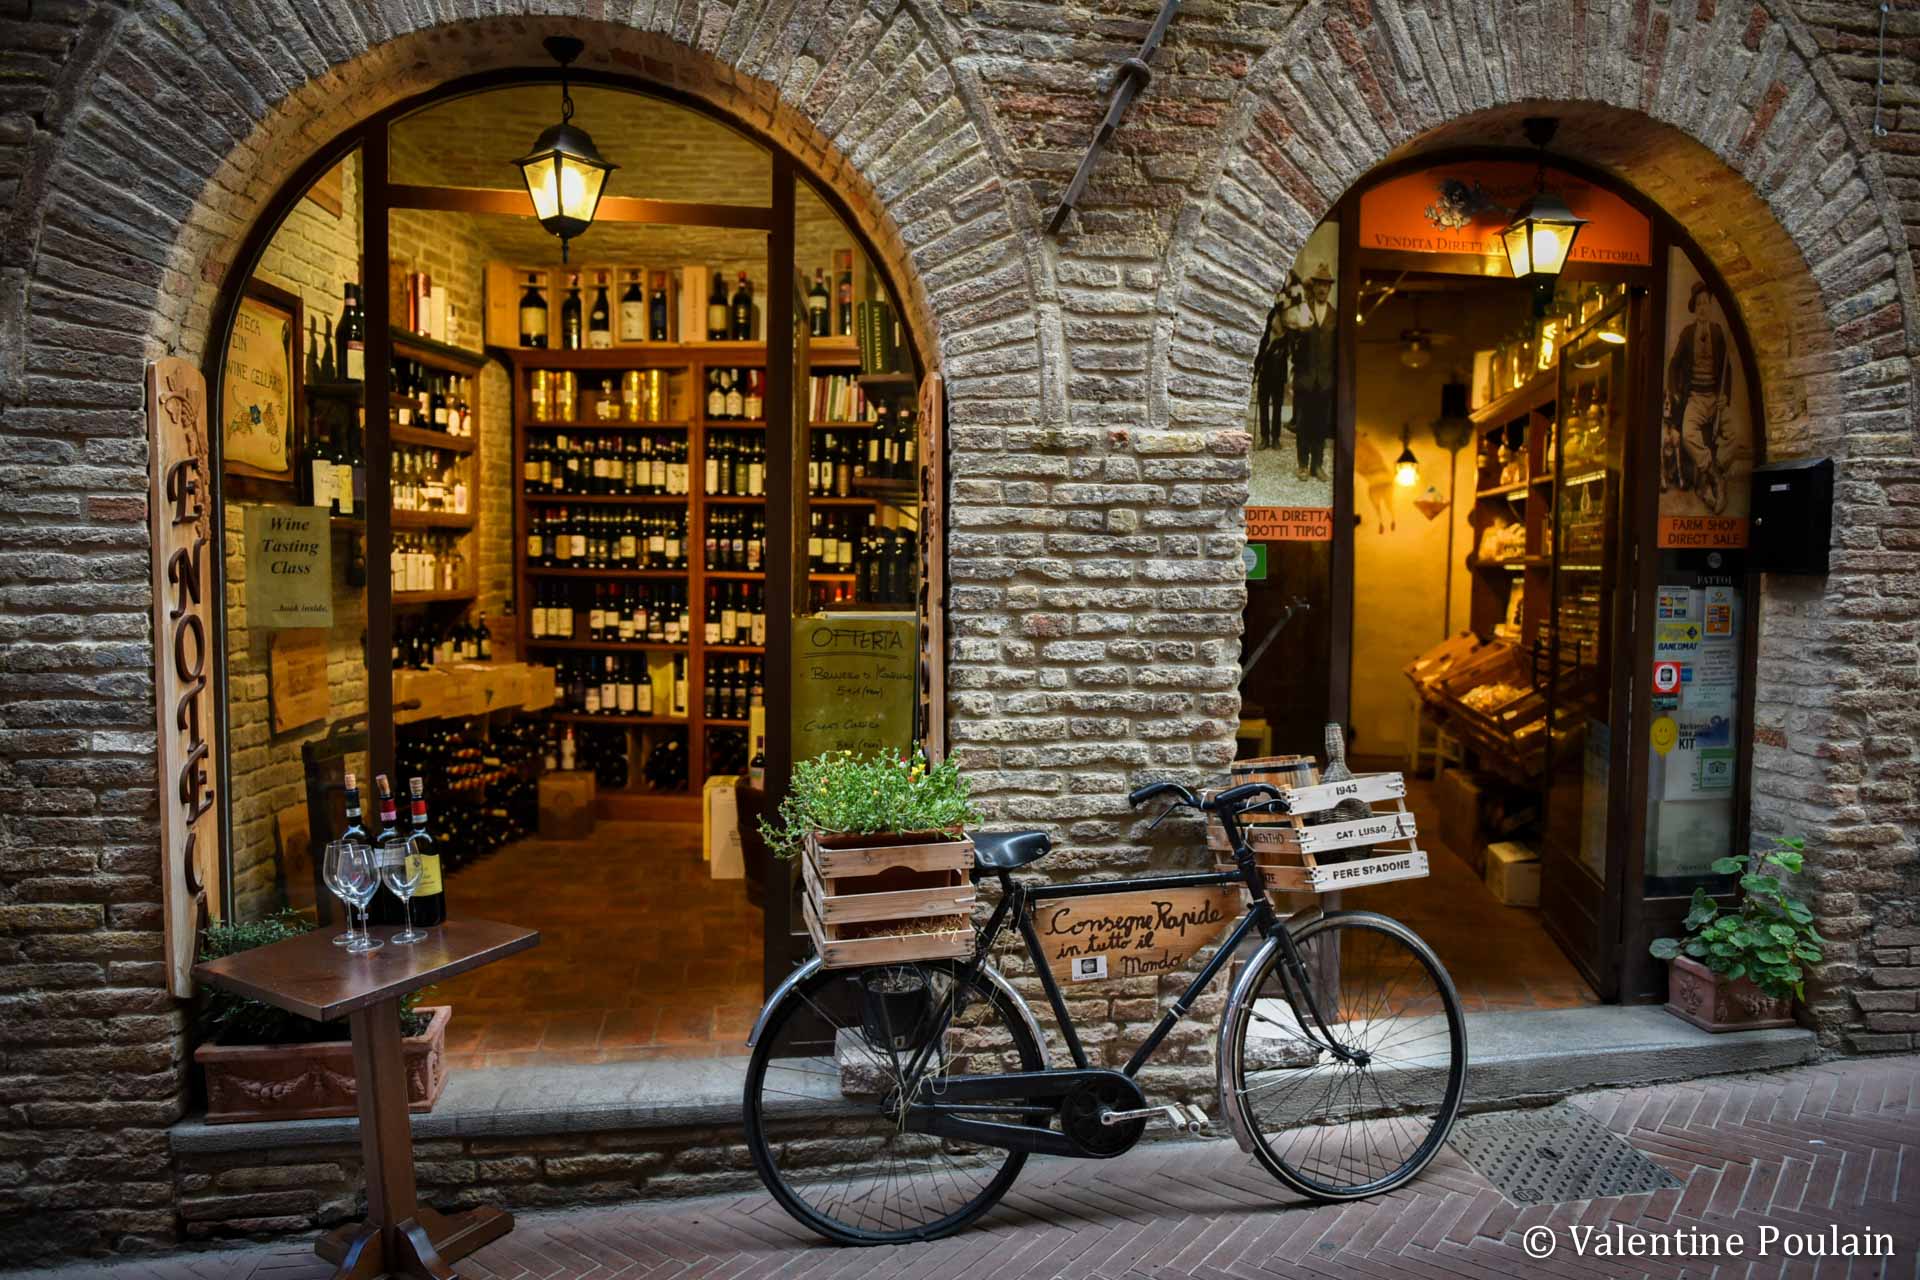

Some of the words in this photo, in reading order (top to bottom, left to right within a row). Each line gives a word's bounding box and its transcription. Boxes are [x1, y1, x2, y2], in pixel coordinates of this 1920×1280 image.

[1375, 234, 1433, 249] VENDITA
[1580, 246, 1641, 262] FATTORIA
[1282, 510, 1333, 522] DIRETTA
[271, 517, 310, 531] Wine
[1294, 525, 1328, 536] TIPICI
[1672, 519, 1703, 530] FARM
[1708, 519, 1737, 530] SHOP
[1668, 534, 1707, 545] DIRECT
[1712, 534, 1740, 545] SALE
[262, 539, 319, 556] Tasting
[271, 561, 311, 574] Class
[811, 627, 903, 649] OFFERTA
[1679, 738, 1696, 750] KIT
[1336, 784, 1358, 796] 1943
[1358, 825, 1387, 836] LUSSO
[1332, 867, 1361, 880] PERE
[1362, 860, 1410, 876] SPADONE
[1045, 908, 1153, 938] Consegne
[1152, 899, 1225, 936] Rapide
[1056, 943, 1081, 960] in
[1085, 932, 1132, 954] tutto
[1135, 931, 1154, 950] il
